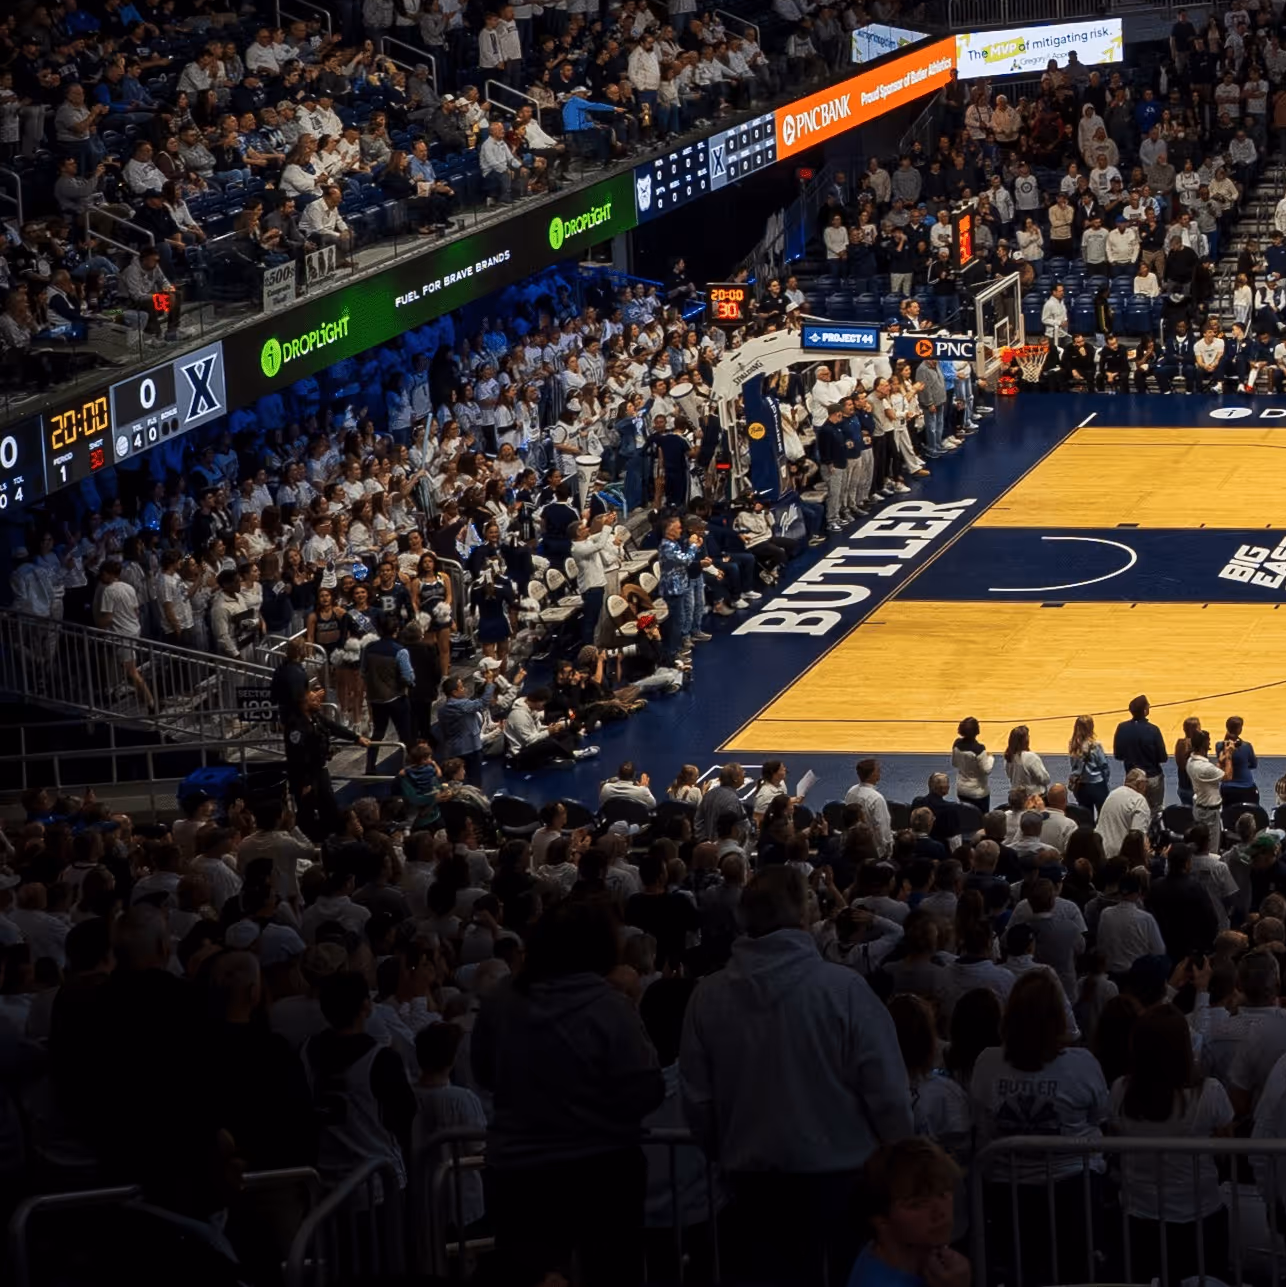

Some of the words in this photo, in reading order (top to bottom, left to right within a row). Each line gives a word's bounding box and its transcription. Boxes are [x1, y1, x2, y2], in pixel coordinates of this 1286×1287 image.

[968, 50, 988, 61] The
[990, 44, 1016, 58] MVP
[1018, 40, 1030, 52] of
[1032, 31, 1088, 50] mitigating
[1090, 26, 1112, 39] risk.
[861, 85, 880, 106] Proud
[880, 78, 904, 100] Sponsor
[904, 72, 910, 88] of
[910, 67, 928, 85] Butler
[928, 56, 952, 77] Athletics
[395, 290, 420, 308] FUEL
[422, 280, 441, 296] FOR
[443, 266, 473, 287] BRAVE
[475, 250, 511, 273] BRANDS
[711, 289, 743, 302] 20:00
[717, 302, 739, 319] 30
[822, 333, 861, 344] PROJECT
[862, 333, 874, 344] 44
[936, 341, 973, 358] PNC
[732, 360, 763, 387] SPALDING
[140, 378, 156, 409] 0
[51, 397, 108, 449] 20:00
[147, 417, 157, 426] FLS
[160, 407, 177, 421] BONUS
[0, 436, 18, 468] 0
[53, 452, 73, 465] PERIOD
[89, 439, 104, 450] SHOT
[134, 433, 142, 448] 4
[60, 466, 67, 482] 1
[90, 449, 105, 470] 30
[15, 487, 23, 501] 4
[731, 498, 977, 636] BUTLER
[1218, 544, 1270, 583] BIG
[238, 690, 272, 698] SECTION
[243, 700, 273, 720] 123
[998, 1079, 1058, 1096] BUTLER
